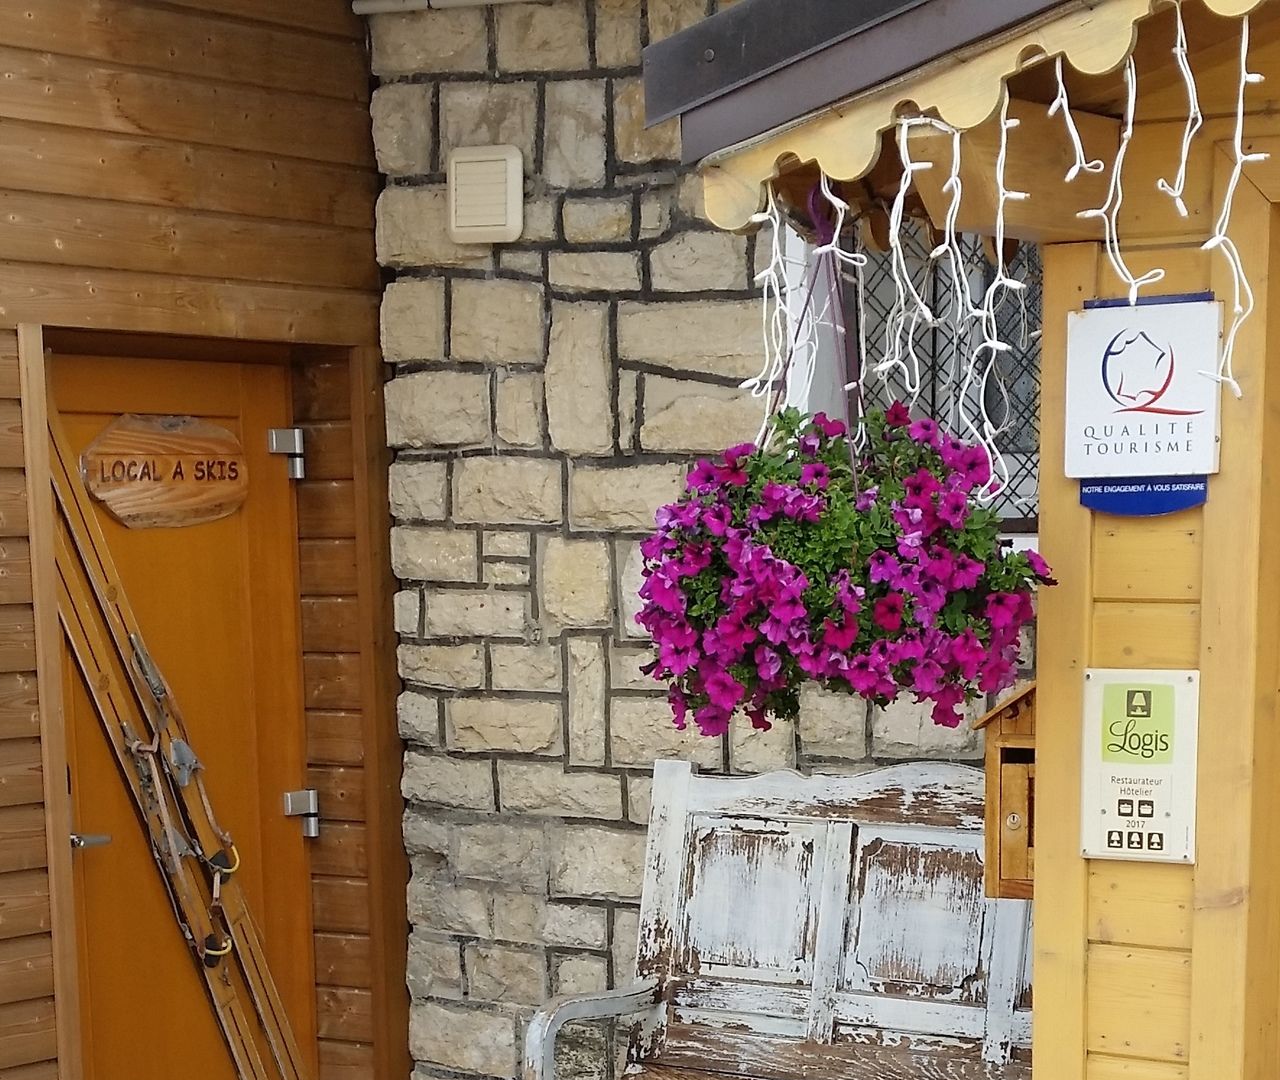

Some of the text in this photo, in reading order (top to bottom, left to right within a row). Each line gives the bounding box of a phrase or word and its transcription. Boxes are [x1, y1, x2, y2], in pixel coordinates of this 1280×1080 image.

[1084, 440, 1193, 456] TOURISME
[101, 460, 239, 482] LOCAL A SKIS
[1082, 486, 1103, 494] NOTRE
[1104, 485, 1145, 493] ENGAGEMENT
[1154, 484, 1170, 492] VOUS
[1171, 483, 1205, 492] SATISFAIRE
[1107, 719, 1169, 759] Logis
[1111, 775, 1163, 786] Restaurateur
[1120, 786, 1153, 796] Hôtelier
[1126, 819, 1146, 829] 2017
